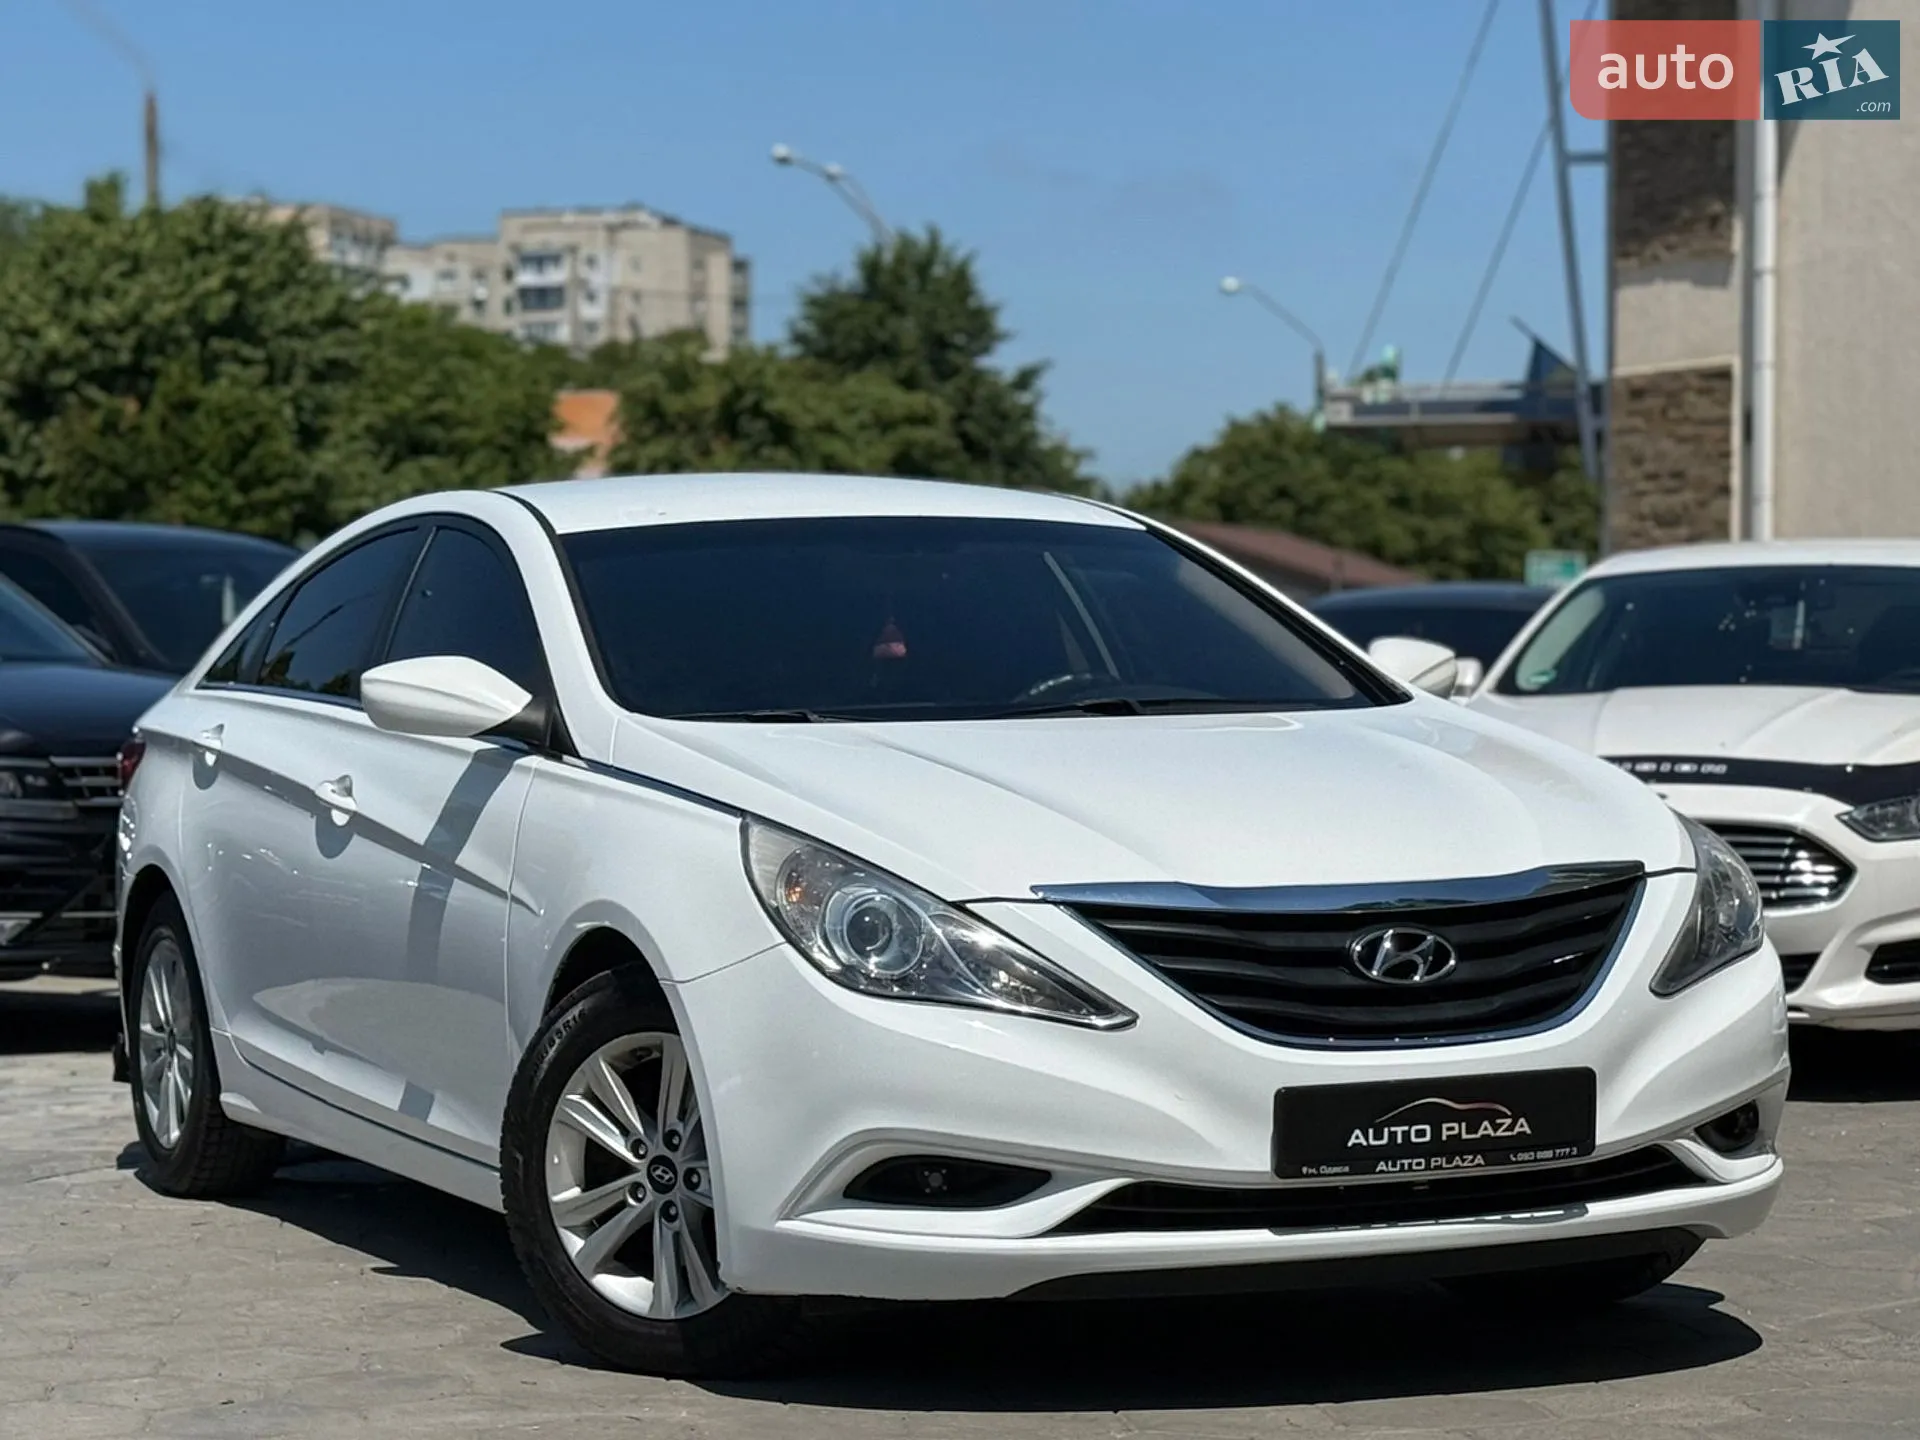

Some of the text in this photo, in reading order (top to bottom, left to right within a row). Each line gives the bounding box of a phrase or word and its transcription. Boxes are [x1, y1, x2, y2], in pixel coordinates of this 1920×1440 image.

[1347, 1117, 1532, 1147] AUTO PLAZA
[1375, 1154, 1485, 1172] AUTO PLAZA
